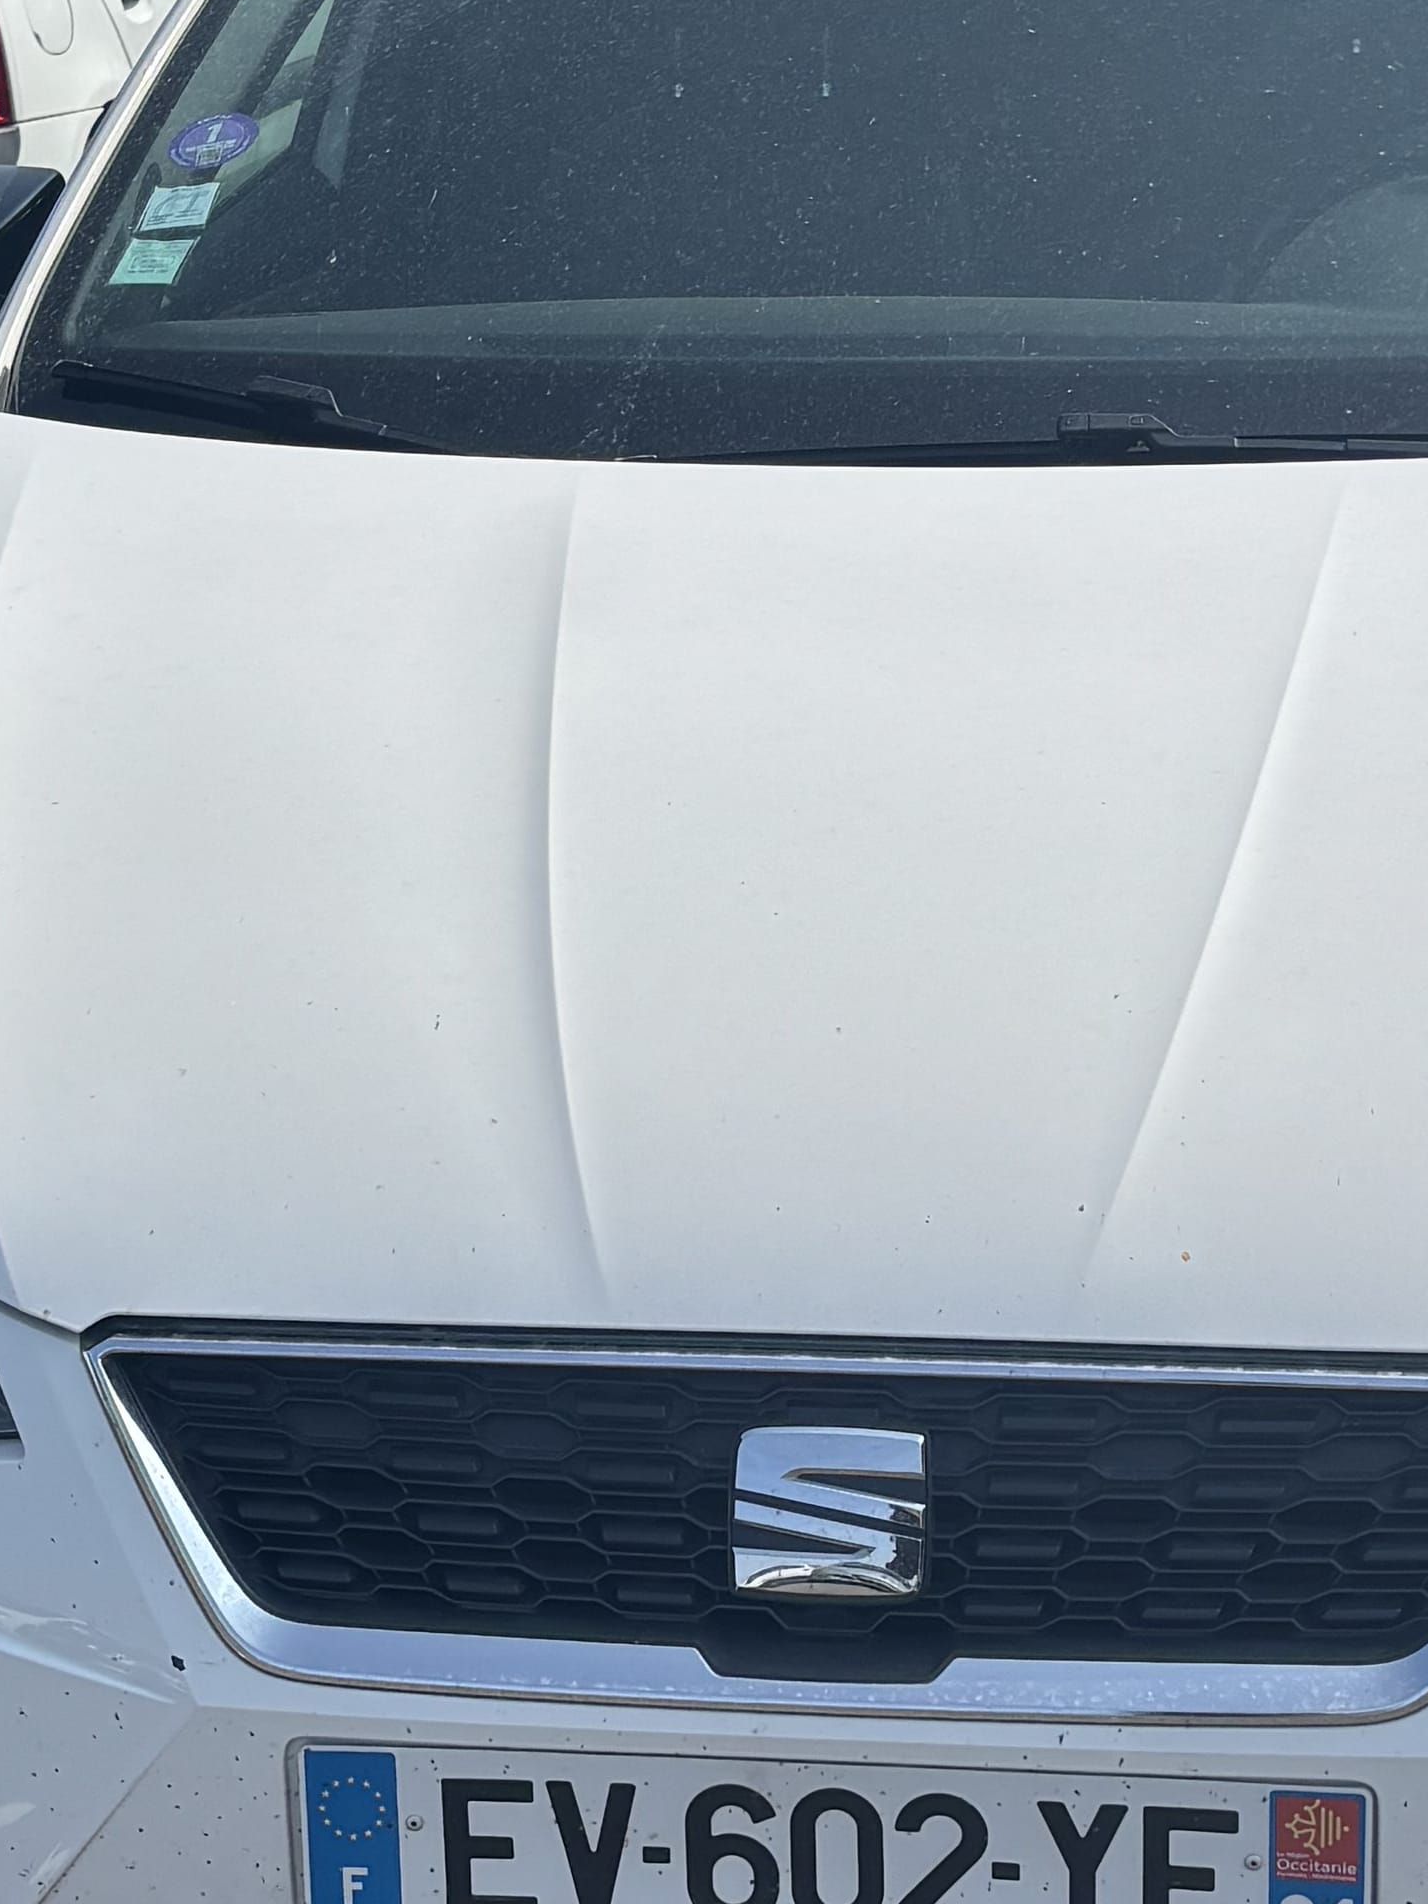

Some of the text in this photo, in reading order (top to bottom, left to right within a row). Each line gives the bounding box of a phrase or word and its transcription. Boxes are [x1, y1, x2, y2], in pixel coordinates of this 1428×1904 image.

[206, 120, 223, 144] 1
[1276, 1857, 1358, 1876] Occitanie
[340, 1866, 369, 1904] F
